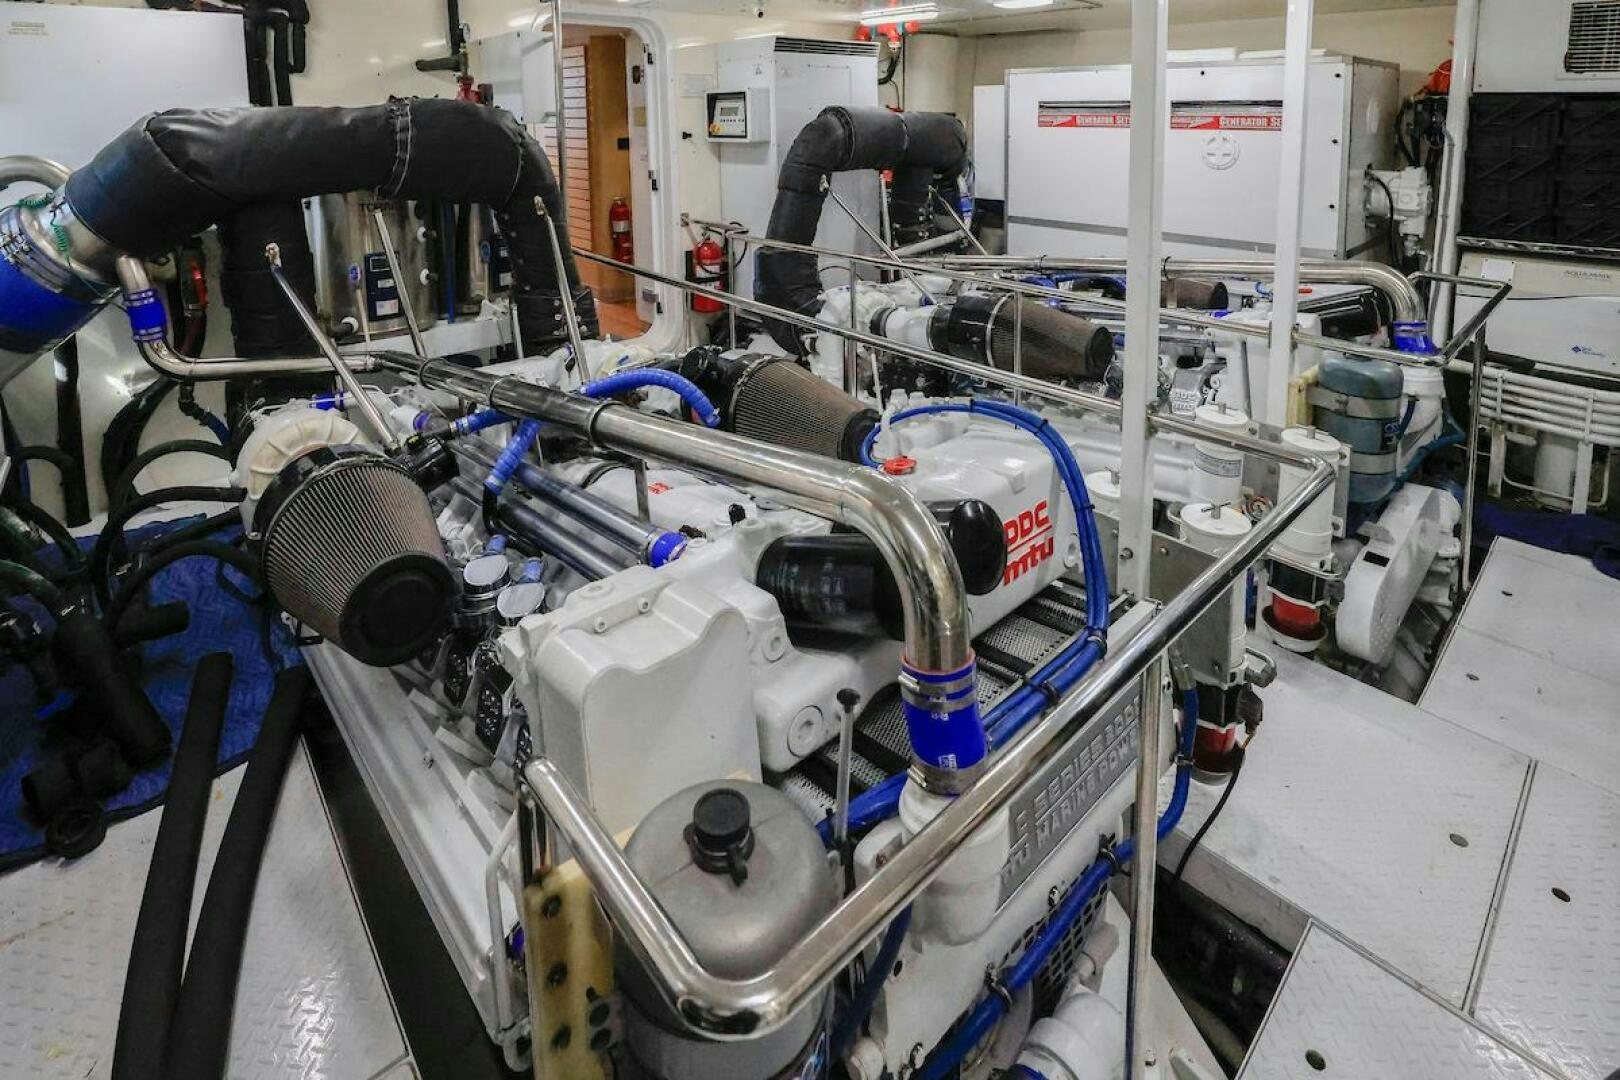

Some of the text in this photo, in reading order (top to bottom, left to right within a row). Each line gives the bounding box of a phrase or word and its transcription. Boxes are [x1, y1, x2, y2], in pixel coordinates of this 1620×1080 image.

[1076, 114, 1112, 125] GENERATOR
[1219, 116, 1282, 129] GENERATOR SE
[1003, 500, 1049, 546] DDC
[1003, 536, 1053, 587] mtu
[1034, 733, 1103, 819] SERIES
[1036, 769, 1096, 849] MARINE
[1098, 727, 1138, 784] POWE
